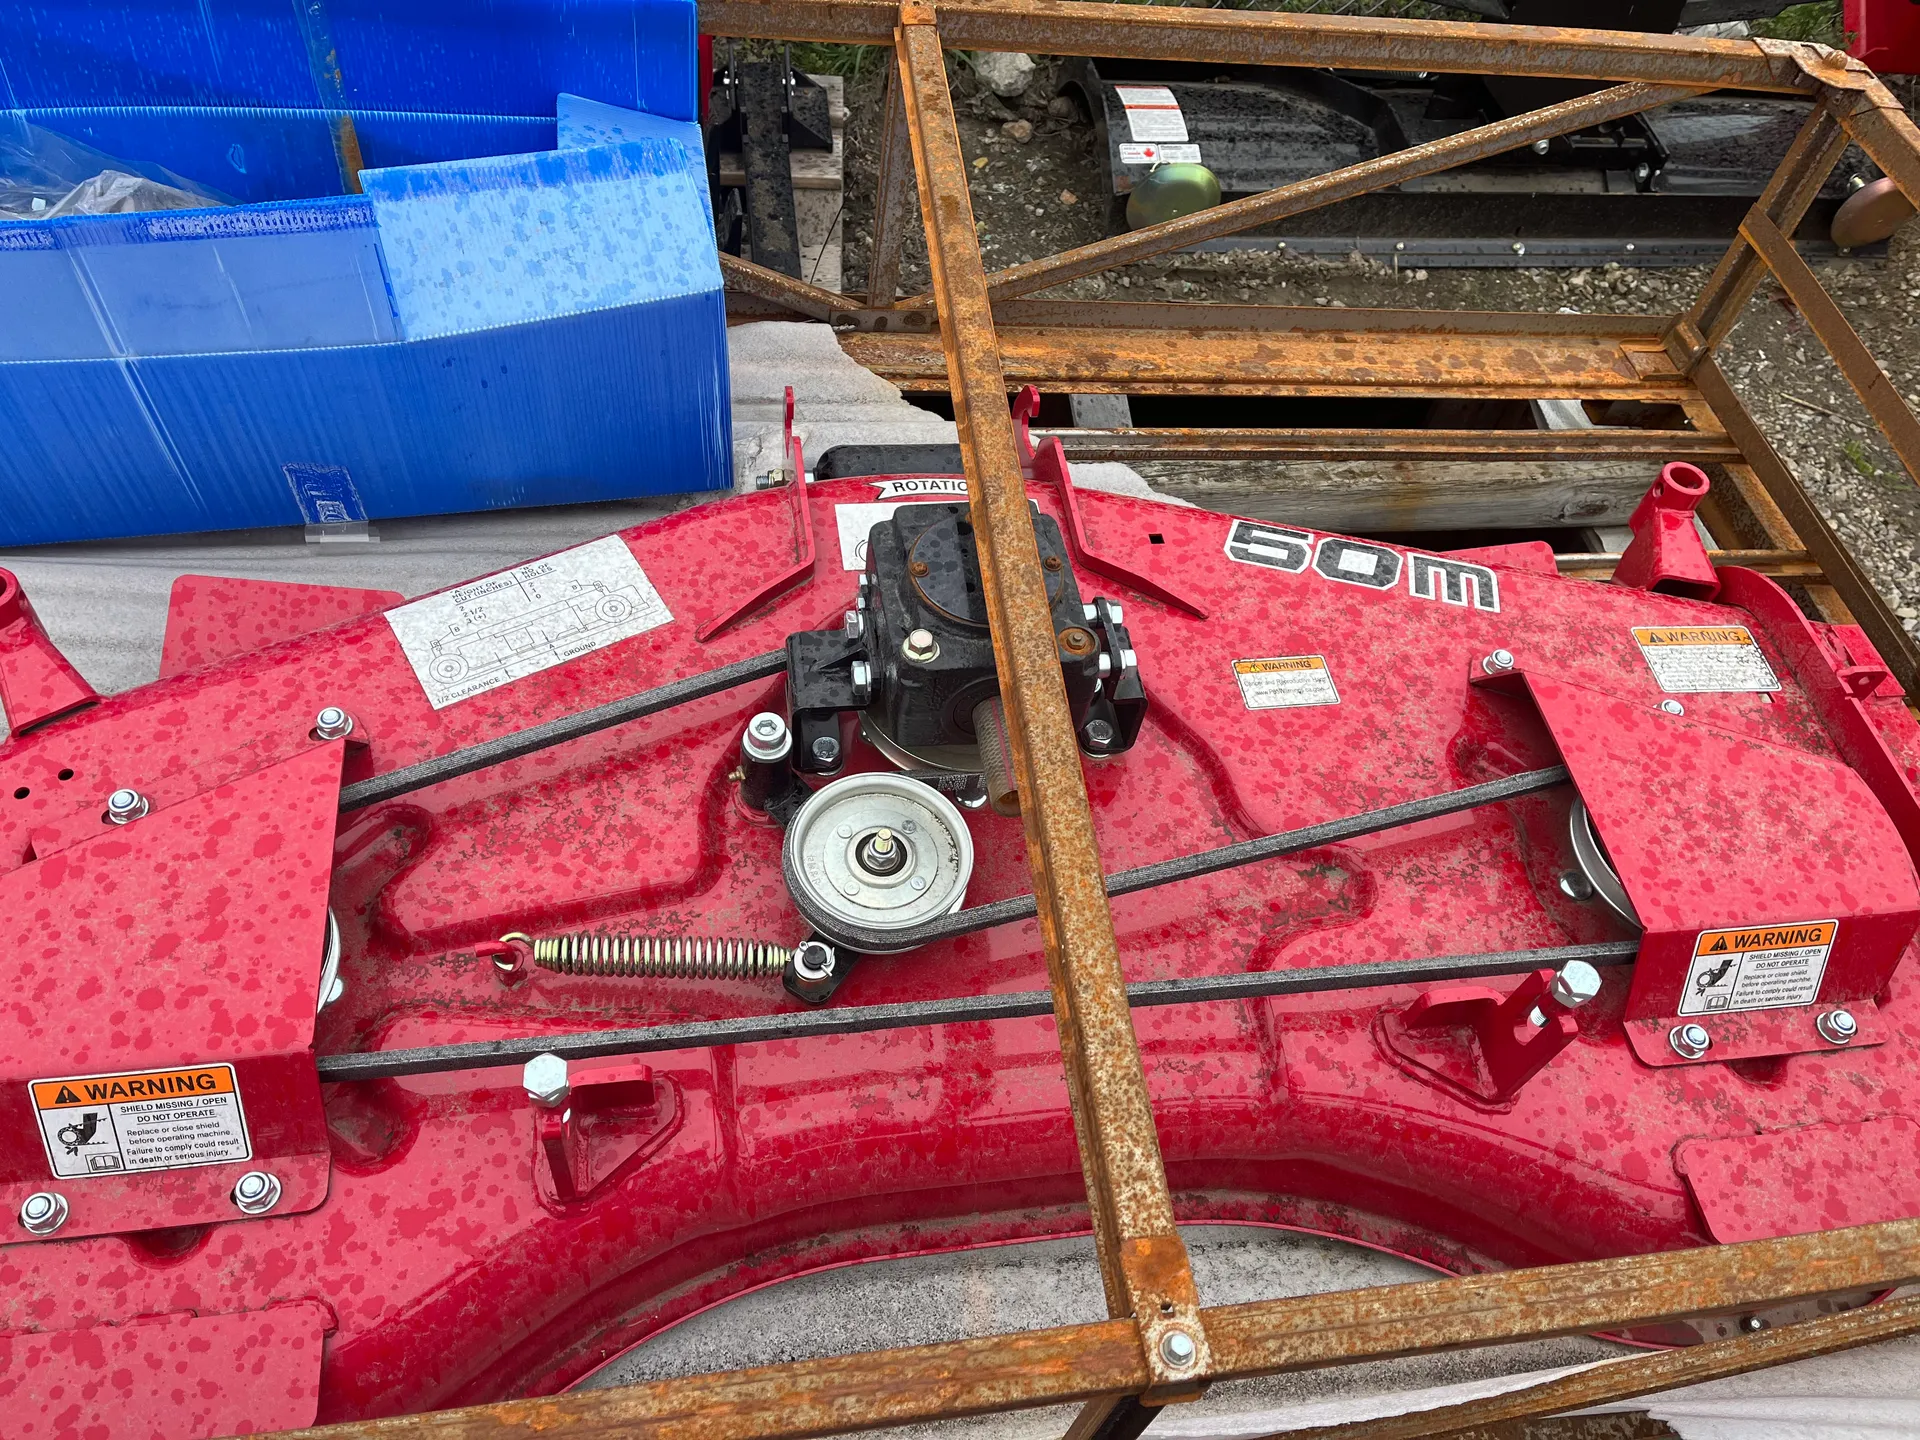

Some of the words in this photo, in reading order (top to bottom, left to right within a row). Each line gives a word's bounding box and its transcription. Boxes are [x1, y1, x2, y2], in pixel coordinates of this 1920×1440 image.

[892, 480, 968, 492] ROTATIO
[524, 567, 553, 579] HOLES
[452, 585, 483, 599] HEIGHT
[455, 594, 472, 603] CUT
[474, 581, 513, 597] (INCHES)
[470, 606, 484, 616] 1/2
[1664, 631, 1740, 642] WARNING
[563, 641, 597, 657] GROUND
[1262, 660, 1312, 671] WARNING
[437, 695, 450, 704] 1/2
[451, 676, 501, 698] CLEARANCE
[1734, 928, 1822, 948] WARNING
[1749, 952, 1772, 960] SHIELD
[1773, 950, 1799, 958] MISSING
[1781, 959, 1809, 967] OPERATE
[1760, 979, 1787, 987] operating
[1761, 987, 1781, 995] comply
[84, 1073, 216, 1100] WARNING
[120, 1103, 153, 1113] SHIELD
[155, 1100, 193, 1110] MISSING
[202, 1097, 227, 1105] OPEN
[137, 1115, 150, 1123] DO
[152, 1113, 171, 1121] NOT
[173, 1109, 215, 1119] OPERATE
[127, 1127, 160, 1137] Replace
[172, 1124, 194, 1133] close
[195, 1122, 220, 1130] shield
[129, 1137, 155, 1145] before
[157, 1133, 195, 1144] operating
[197, 1129, 233, 1138] machine.
[127, 1146, 154, 1156] Failure
[164, 1143, 192, 1153] comply
[194, 1139, 216, 1149] could
[217, 1137, 240, 1146] result
[138, 1155, 162, 1164] death
[174, 1152, 205, 1160] serious
[206, 1148, 232, 1158] injury.
